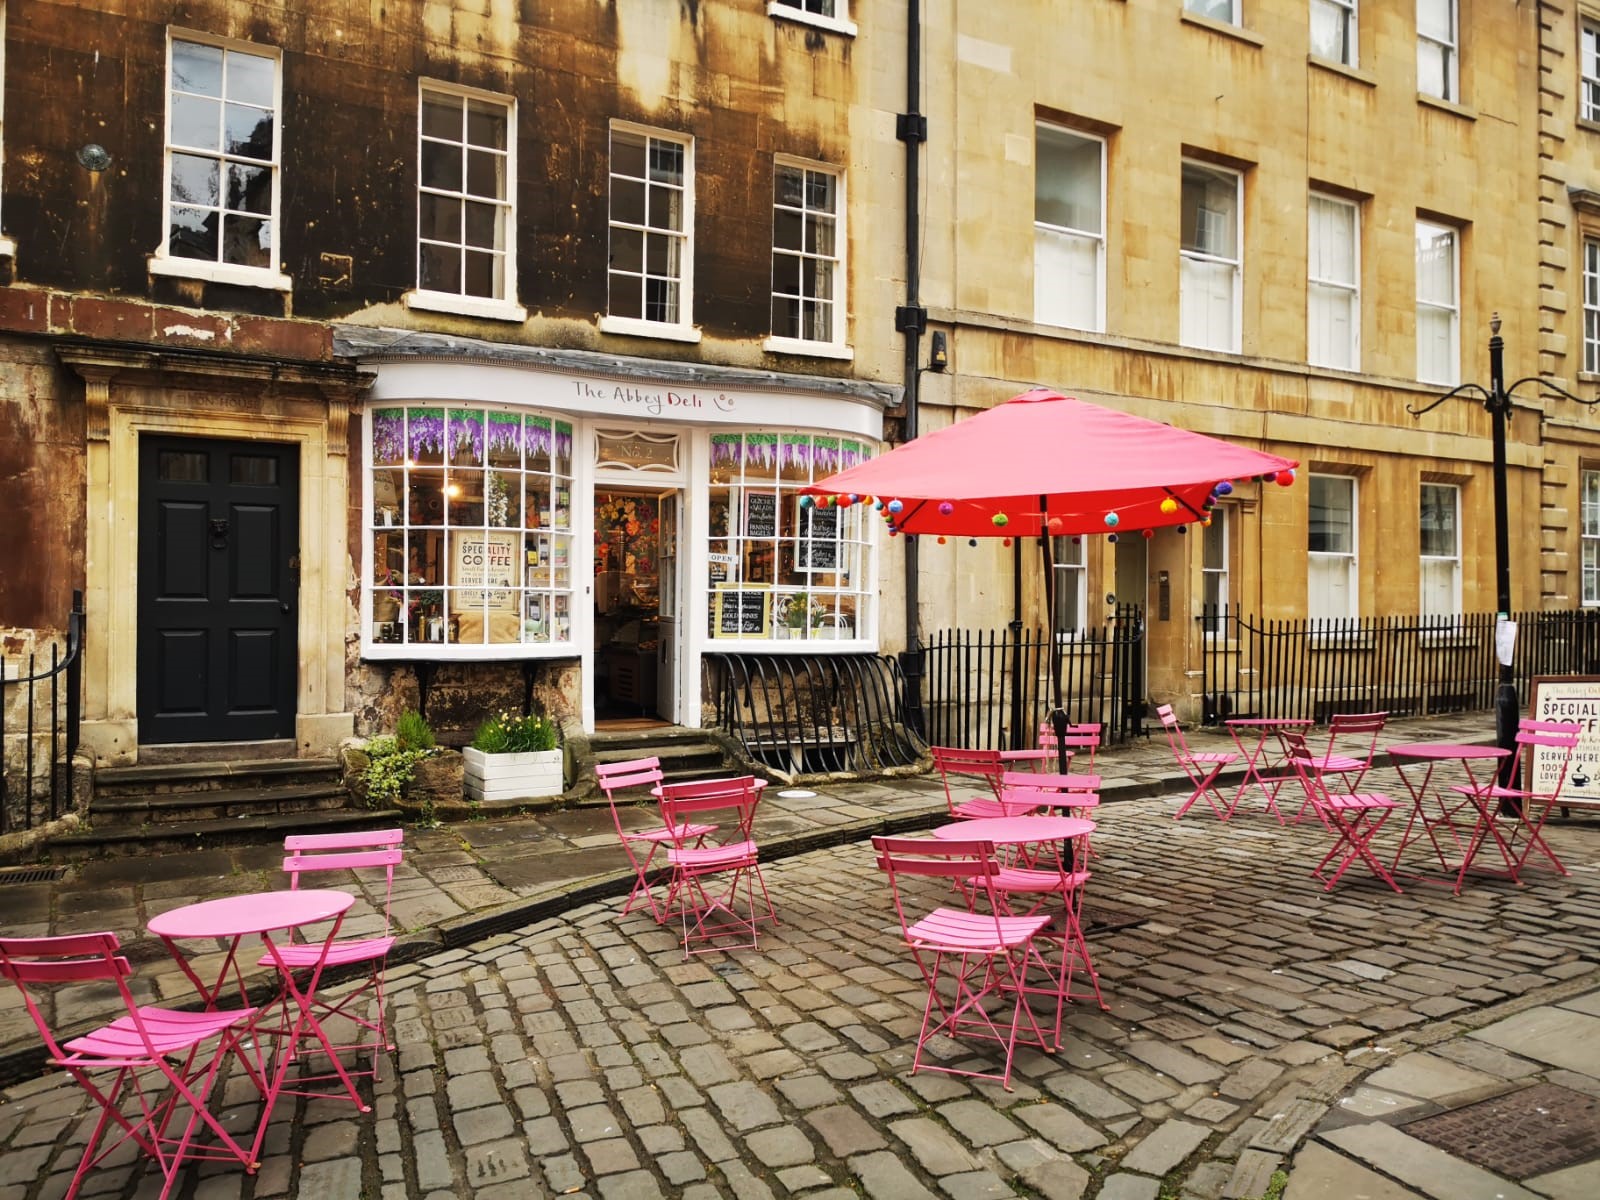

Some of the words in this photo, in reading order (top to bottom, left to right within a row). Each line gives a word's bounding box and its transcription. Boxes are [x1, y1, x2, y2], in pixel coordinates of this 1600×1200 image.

[571, 381, 606, 398] The
[613, 386, 664, 415] Abbey
[667, 391, 702, 408] Deli
[646, 447, 653, 459] 2
[462, 545, 511, 555] SPECALITY
[462, 554, 511, 566] COFEE
[711, 554, 732, 562] OPEN
[1543, 703, 1598, 716] SPECIAL
[1540, 752, 1573, 761] SERVED
[1576, 753, 1599, 763] HERE
[1540, 772, 1566, 781] LOVEL
